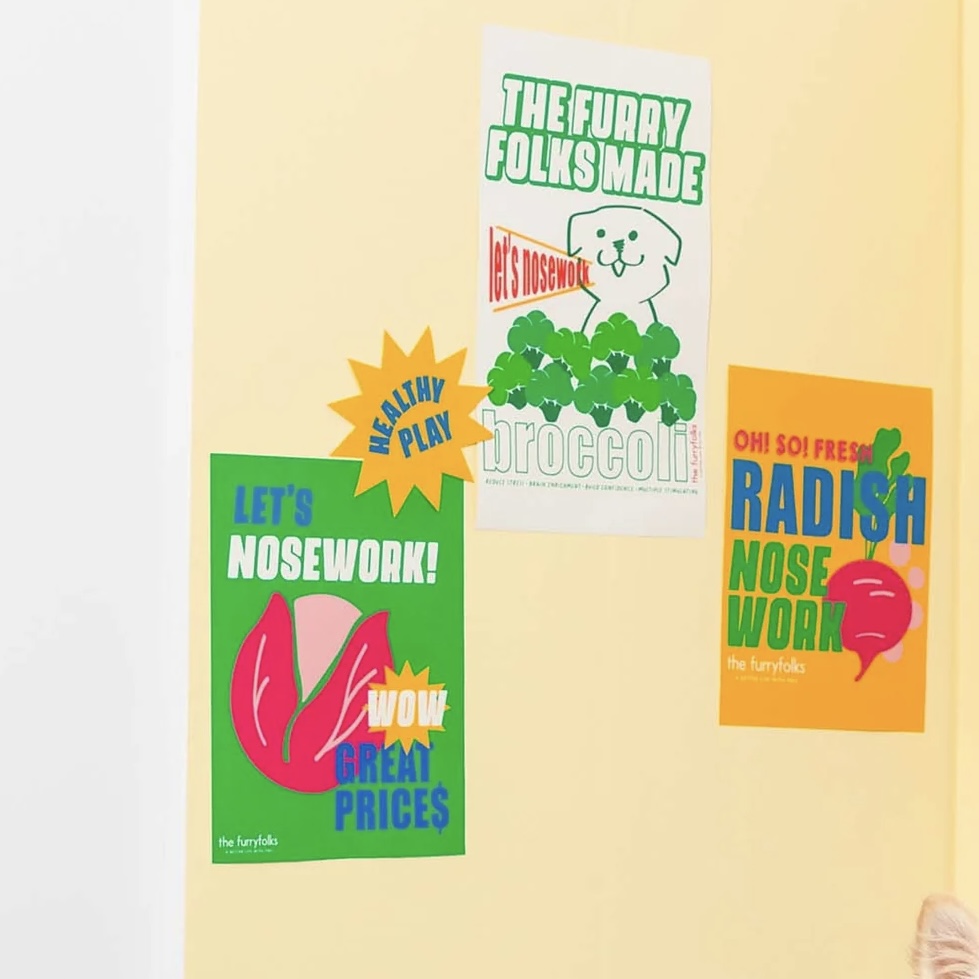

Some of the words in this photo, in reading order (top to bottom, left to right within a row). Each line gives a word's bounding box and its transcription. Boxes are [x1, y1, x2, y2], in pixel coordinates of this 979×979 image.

[502, 73, 572, 134] THE
[572, 84, 691, 149] FURRY
[485, 125, 599, 193] FOLKS
[602, 143, 706, 206] MADE
[489, 226, 519, 303] let's
[522, 248, 590, 297] nosework
[368, 375, 445, 455] HEALTHY
[398, 410, 452, 458] PLAY
[482, 409, 688, 483] broccoli
[733, 430, 770, 453] OH!
[776, 433, 808, 457] SO!
[814, 438, 873, 465] FRESH
[234, 484, 313, 527] LET'S
[731, 458, 926, 546] RADISH
[227, 534, 439, 584] NOSEWORK!
[728, 539, 832, 597] NOSE
[727, 594, 847, 653] WORK
[727, 654, 746, 671] the
[751, 655, 806, 675] furryfolks
[367, 689, 448, 727] WOW
[335, 742, 434, 785] GREAT
[219, 835, 234, 848] the
[237, 834, 278, 849] furryfolks
